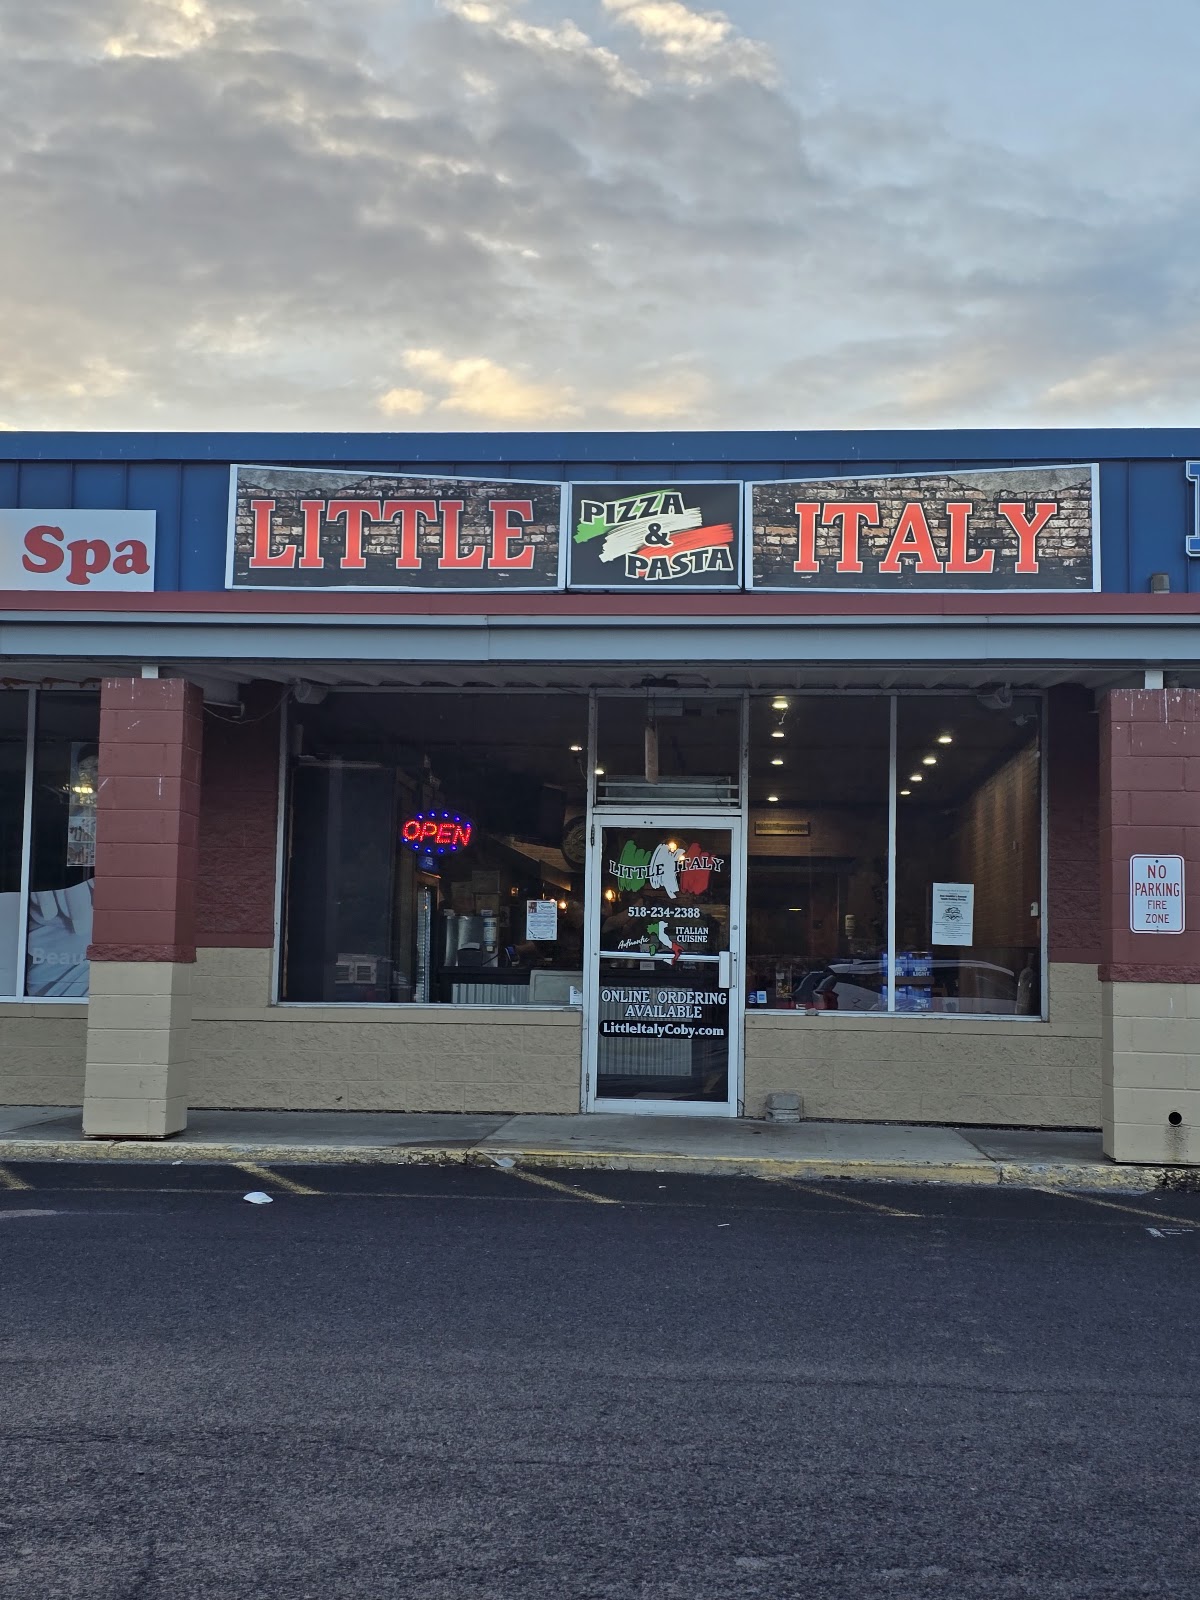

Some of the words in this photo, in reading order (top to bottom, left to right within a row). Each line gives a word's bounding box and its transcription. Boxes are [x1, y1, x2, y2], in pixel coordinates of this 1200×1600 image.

[581, 492, 685, 526] PIZZA
[248, 499, 535, 570] LITTLE
[645, 522, 673, 548] &
[793, 502, 1058, 574] ITALY
[22, 525, 150, 585] Spa
[625, 546, 734, 580] PASTA
[403, 820, 471, 846] OPEN
[609, 860, 664, 879] LITTLE
[674, 856, 724, 873] ITALY
[1147, 865, 1166, 879] NO
[1135, 882, 1180, 897] PARKING
[1147, 900, 1167, 909] FIRE
[628, 907, 700, 919] 518-234-2388
[1146, 914, 1170, 923] ZONE
[675, 927, 709, 935] ITALIAN
[676, 935, 708, 943] CUISINE
[601, 990, 650, 1003] ONLINE
[657, 991, 727, 1005] ORDERING
[625, 1005, 702, 1018] AVAILABLE
[603, 1022, 724, 1038] LittleItalyCoby.com
